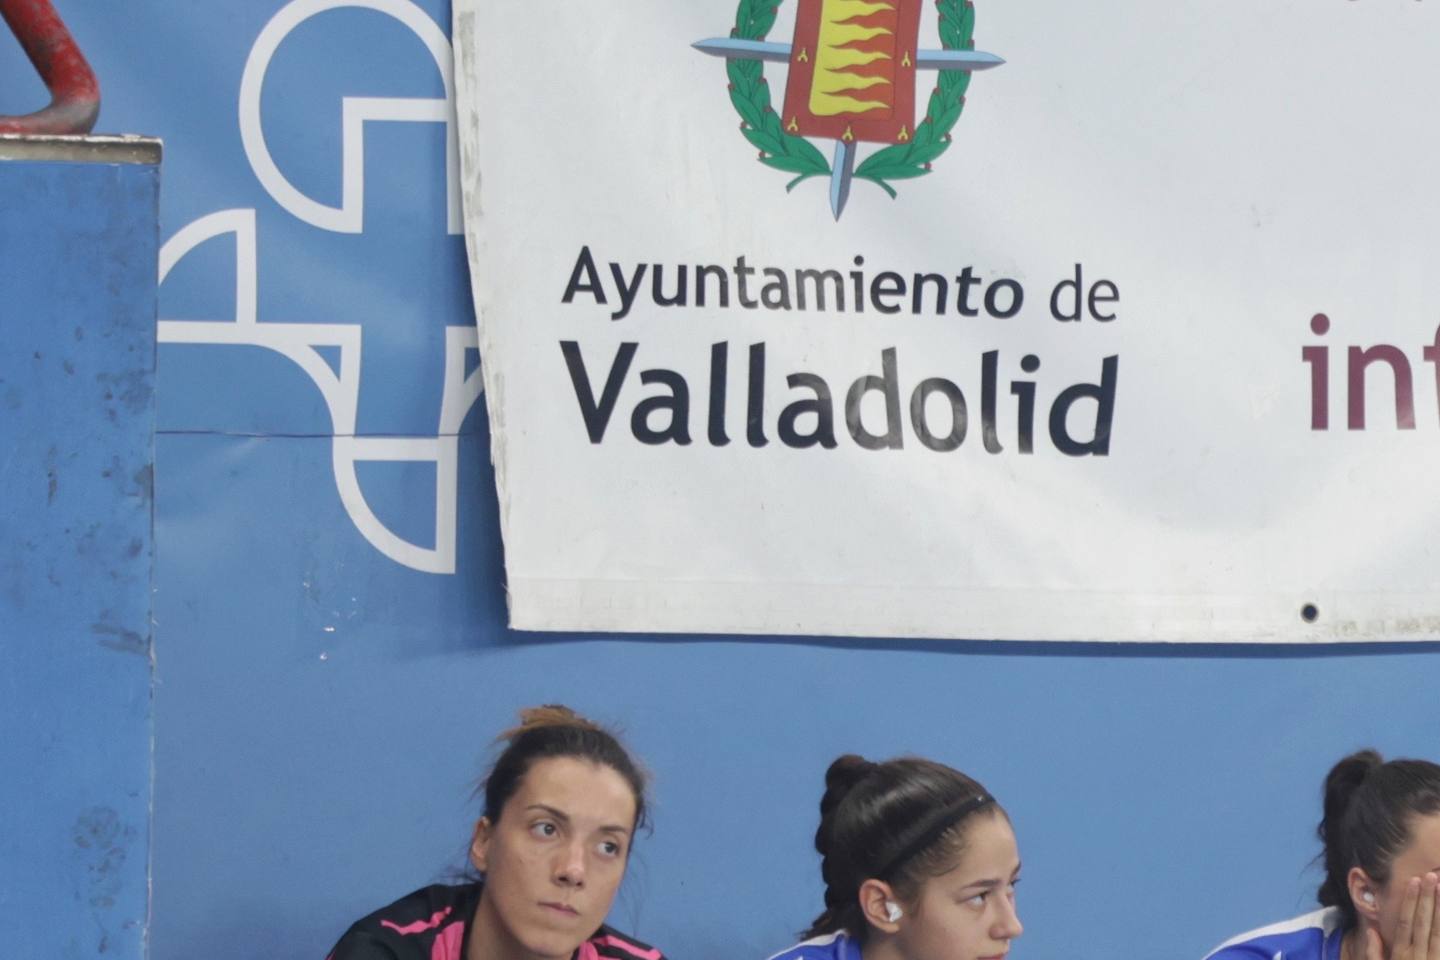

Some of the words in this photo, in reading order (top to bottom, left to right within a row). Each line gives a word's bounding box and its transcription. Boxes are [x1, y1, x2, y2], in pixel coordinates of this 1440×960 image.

[561, 245, 1025, 322] Ayuntamiento
[1049, 263, 1120, 323] de
[559, 340, 1119, 457] Valladolid
